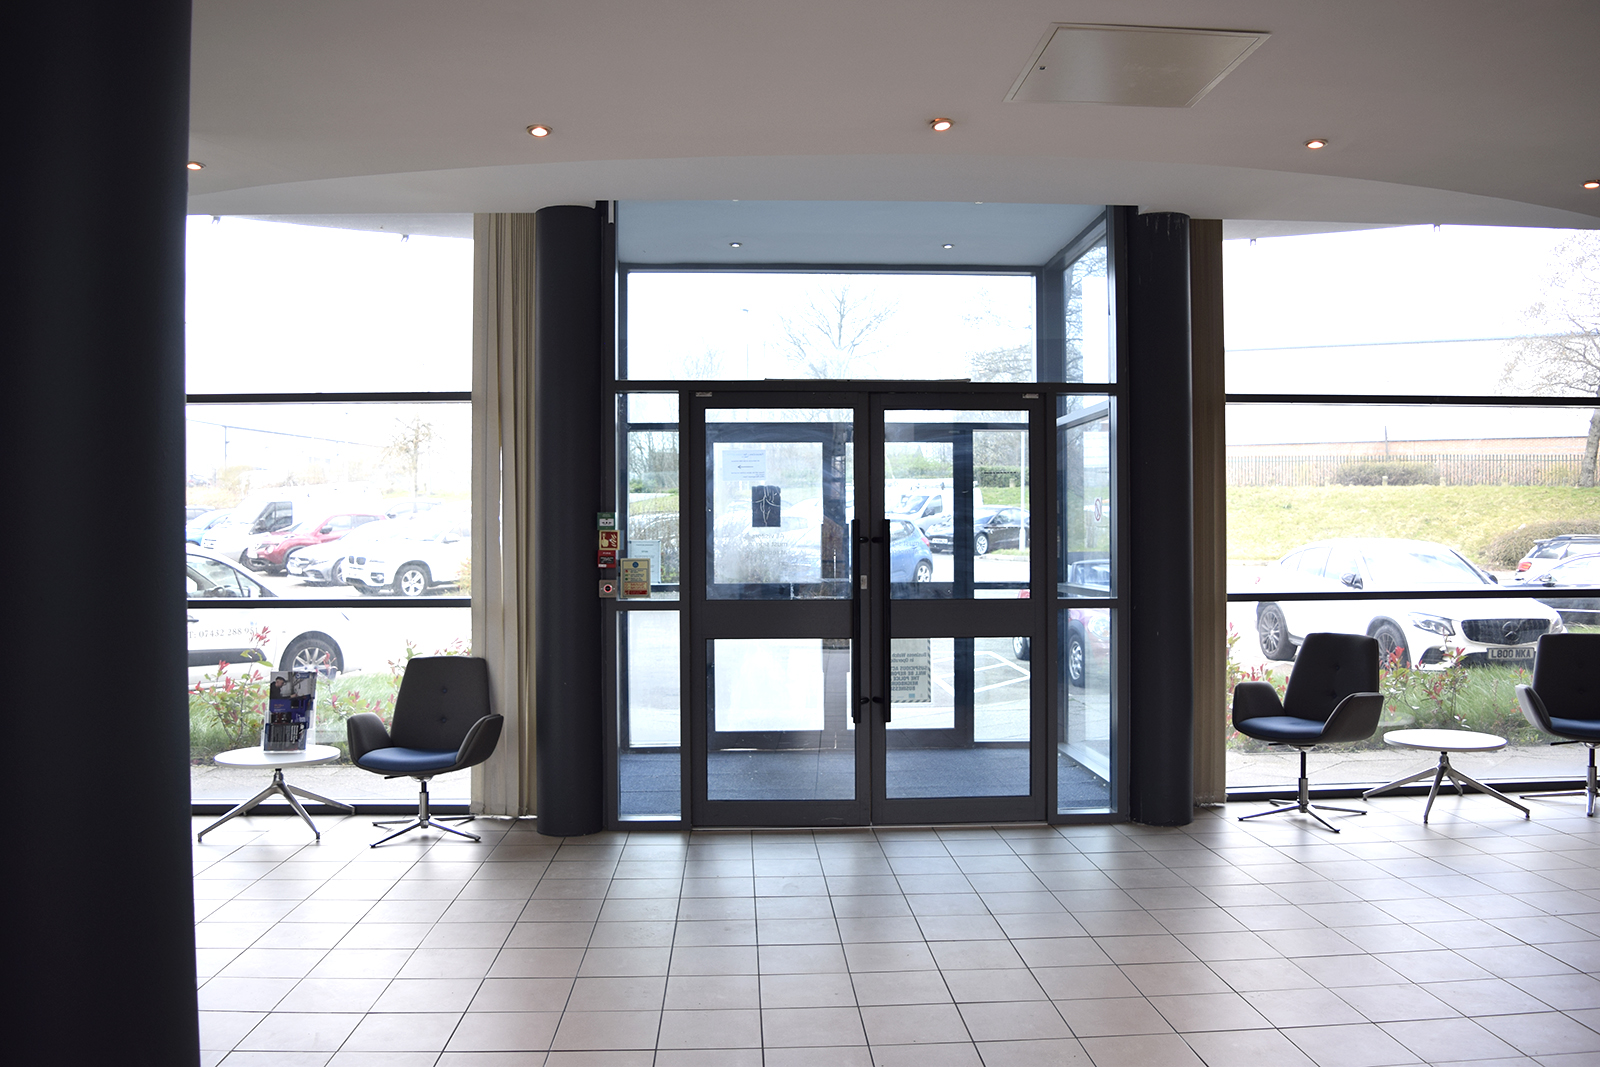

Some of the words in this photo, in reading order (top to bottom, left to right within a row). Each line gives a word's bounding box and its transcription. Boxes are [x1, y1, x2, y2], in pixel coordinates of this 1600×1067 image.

[198, 628, 225, 638] 07432
[227, 627, 243, 636] 288
[1491, 649, 1514, 658] L800
[1515, 649, 1531, 658] NKA
